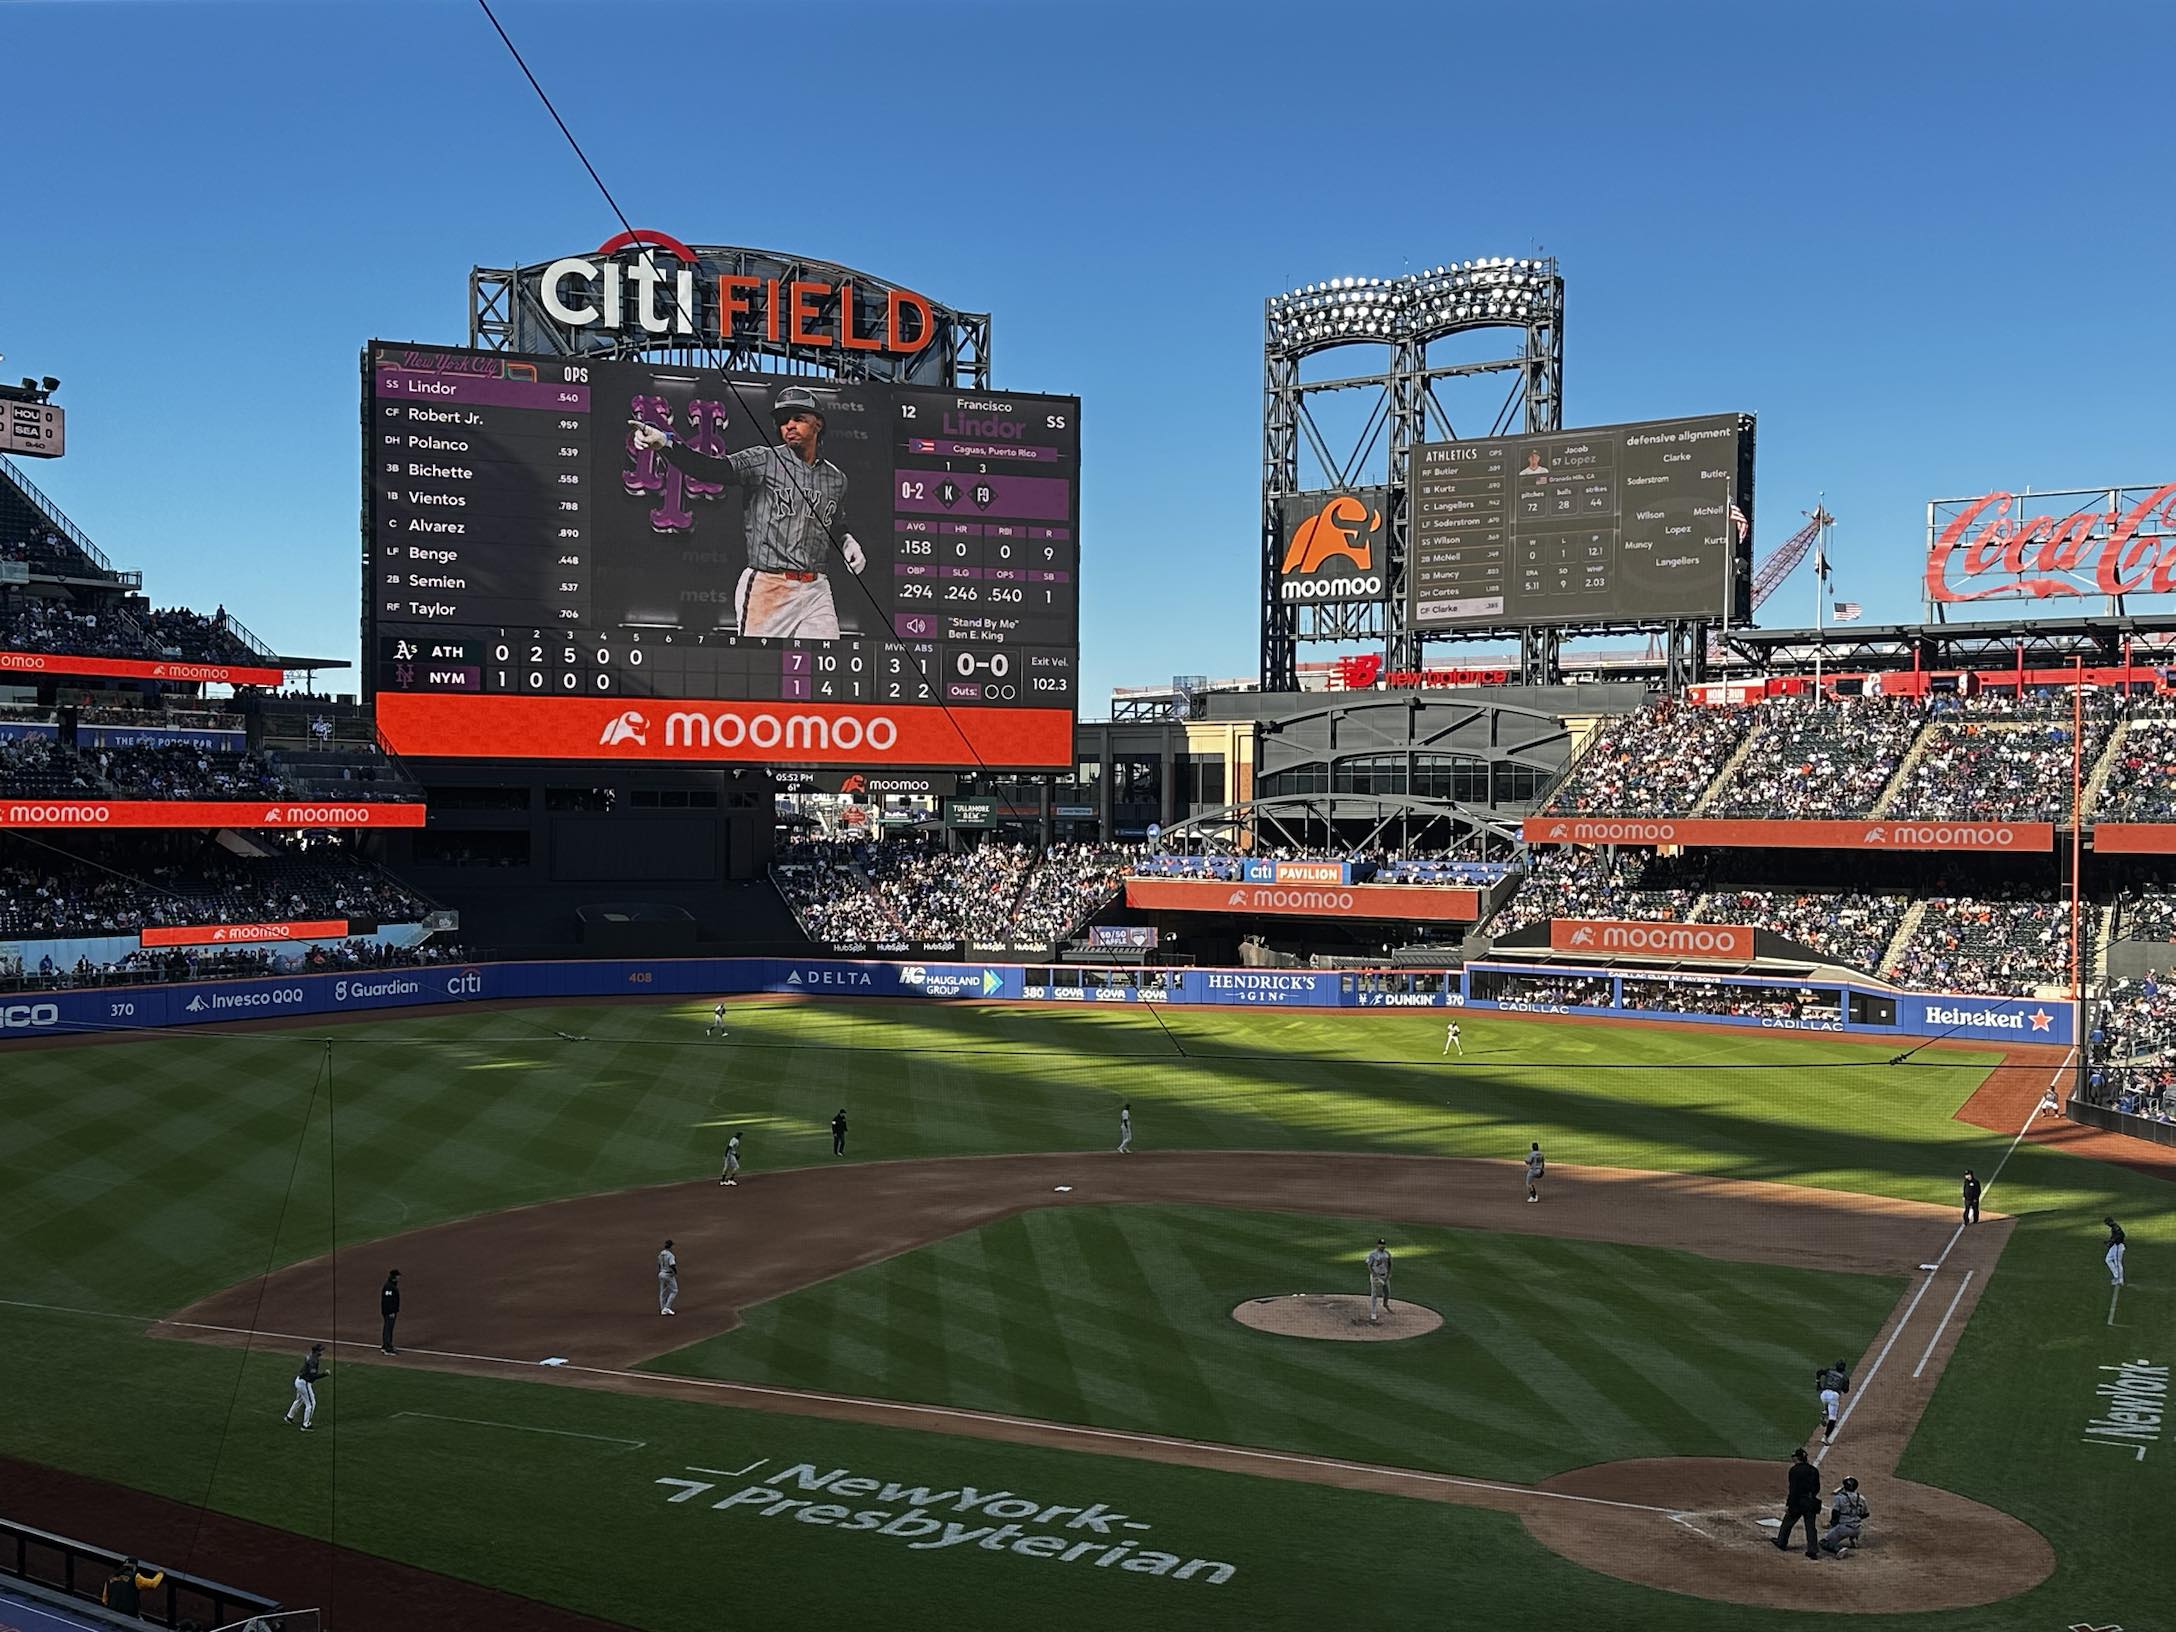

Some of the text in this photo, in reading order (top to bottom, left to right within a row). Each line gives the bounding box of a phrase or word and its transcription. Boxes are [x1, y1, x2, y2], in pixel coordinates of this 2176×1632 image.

[718, 275, 933, 352] FIELD
[404, 352, 499, 374] New York City
[564, 366, 588, 382] OPS
[408, 381, 578, 402] Lindor .540
[902, 406, 916, 418] 12
[957, 399, 1012, 413] Francisco
[15, 409, 39, 419] HOU
[408, 409, 578, 429] Robert Jr. .959
[943, 414, 1025, 439] Lindor
[1047, 416, 1065, 429] SS
[15, 426, 38, 436] SEA
[1627, 428, 1731, 446] defensive alignment
[408, 436, 578, 457] Polanco .539
[953, 445, 1036, 458] Caguas, Puerto Rico
[1565, 445, 1588, 454] Jacob
[1426, 449, 1477, 462] ATHLETICS
[1565, 456, 1596, 466] Lopez
[1663, 453, 1691, 462] Clarke
[409, 464, 578, 484] Bichette .558
[1627, 475, 1669, 485] Soderstrom
[1701, 470, 1727, 479] Butler
[902, 483, 923, 499] 0-2
[1521, 491, 1544, 499] pitches
[408, 492, 578, 511] Vientos .788
[1434, 502, 1474, 511] Langeliers
[1528, 503, 1537, 511] 72
[1559, 501, 1570, 509] 28
[1637, 512, 1664, 520] Wilson
[1694, 506, 1723, 515] McNeil
[409, 519, 579, 538] Alvarez .890
[907, 523, 925, 531] AVG
[955, 525, 967, 533] HR
[1434, 519, 1480, 527] Soderstrom
[1666, 526, 1691, 535] Lopez
[901, 540, 931, 554] .158
[1625, 541, 1653, 549] Muncy
[409, 547, 579, 565] Benge .448
[1434, 553, 1460, 561] McNeil
[1589, 548, 1602, 556] 12.1
[1656, 557, 1699, 567] Langeliers
[907, 566, 1013, 579] OBP SLG OPS
[1433, 571, 1459, 580] Muncy
[409, 574, 578, 592] Semien .537
[1281, 576, 1381, 599] moomoo
[1526, 578, 1604, 590] 5.11 2.03
[900, 584, 1022, 602] .294 .246 .540
[1433, 588, 1459, 596] Cortes
[409, 602, 578, 618] Taylor .706
[1432, 605, 1458, 613] Clarke
[949, 616, 1018, 629] "Stand By Me"
[949, 630, 1003, 642] Ben E. King
[432, 646, 542, 662] ATH 0 2
[915, 644, 933, 652] ABS
[818, 657, 836, 670] 10
[957, 653, 1008, 676] 0-0
[1032, 657, 1068, 667] Exit Vel.
[169, 666, 229, 679] moomoo
[430, 672, 465, 684] NYM
[1385, 669, 1507, 686] new balance
[951, 686, 977, 696] Outs:
[1033, 678, 1067, 691] 102.3
[666, 712, 899, 748] moomoo
[115, 737, 133, 745] THE
[870, 780, 929, 790] moomoo
[10, 806, 109, 822] moomoo
[287, 806, 369, 822] moomoo
[1575, 824, 1674, 839] moomoo
[1894, 828, 2013, 845] moomoo
[1251, 865, 1338, 881] citi PAVILION
[1254, 891, 1352, 909] moomoo
[229, 925, 289, 938] moomoo
[924, 942, 955, 950] HubSpot
[1604, 927, 1735, 952] moomoo
[447, 972, 481, 994] citi
[808, 971, 871, 985] DELTA
[927, 976, 979, 986] HAUGLAND
[1208, 975, 1316, 991] HENDRICK'S
[351, 980, 418, 998] Guardian
[927, 985, 959, 994] GROUP
[1023, 987, 1044, 998] 380
[1055, 988, 1084, 997] GOYA
[1096, 989, 1125, 998] GOYA
[1137, 990, 1167, 999] GOYA
[1248, 990, 1278, 1001] GIN
[213, 988, 303, 1009] Invesco QQQ
[1385, 994, 1435, 1005] DUNKIN'
[1446, 995, 1464, 1004] 370
[111, 1004, 134, 1016] 370
[1499, 1002, 1569, 1014] CADILLAC
[1926, 1007, 2024, 1028] Heineken
[1762, 1018, 1843, 1031] CADILLAC
[2085, 1359, 2168, 1440] NewYork-
[764, 1464, 1151, 1534] NewYork-
[712, 1487, 1237, 1584] Presbyterian
